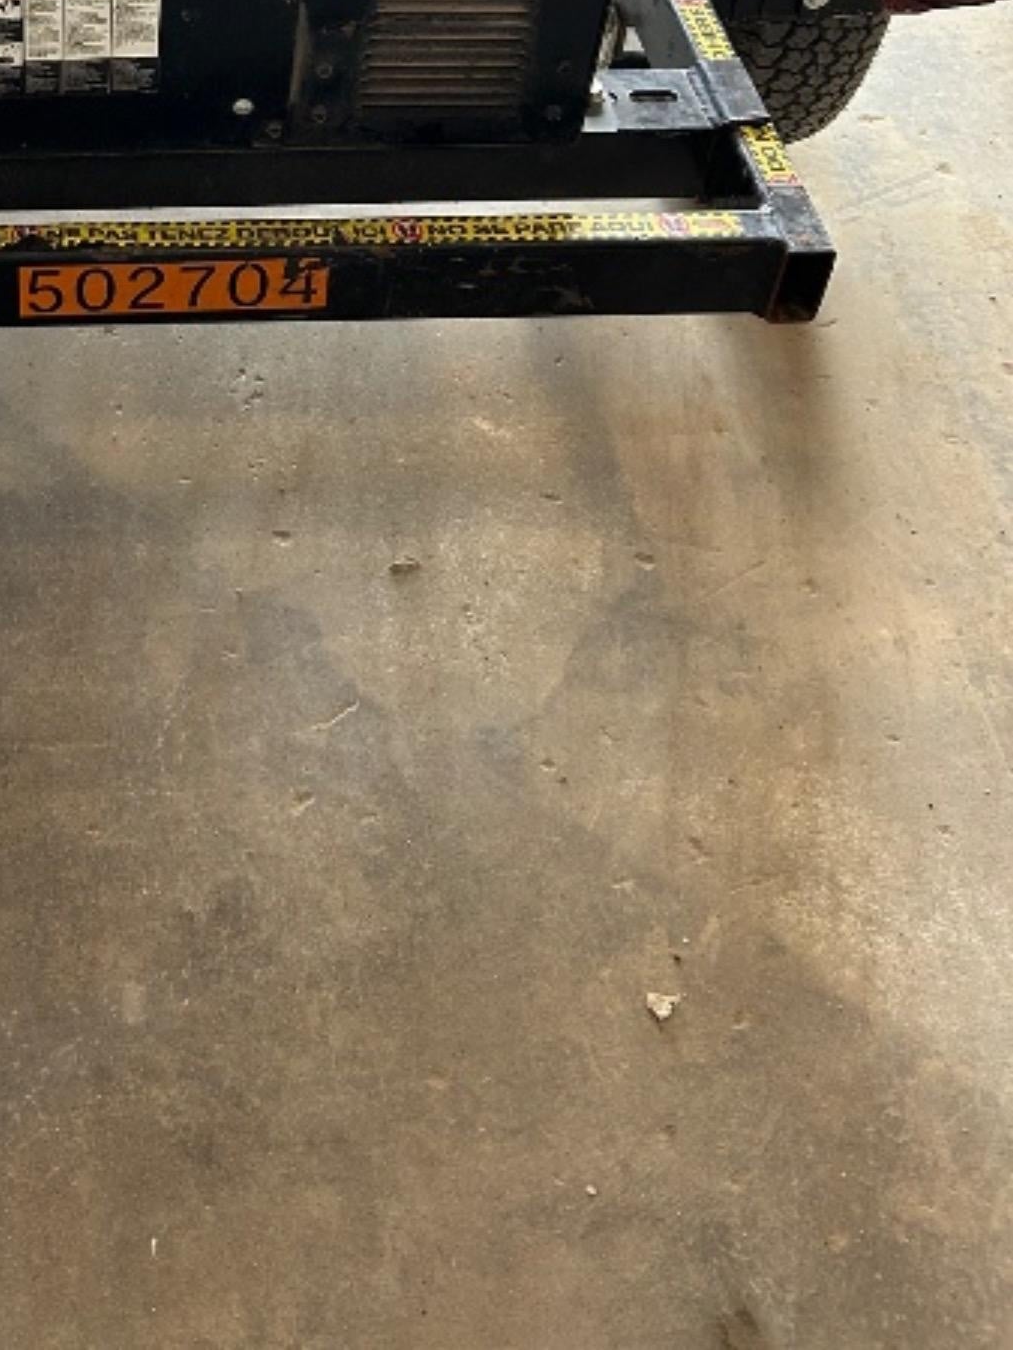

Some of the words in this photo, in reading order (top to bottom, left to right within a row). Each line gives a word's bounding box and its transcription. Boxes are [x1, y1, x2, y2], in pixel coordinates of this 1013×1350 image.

[88, 227, 137, 240] PAS
[428, 224, 464, 235] NO
[515, 221, 582, 235] PARE
[28, 262, 319, 313] 502704
